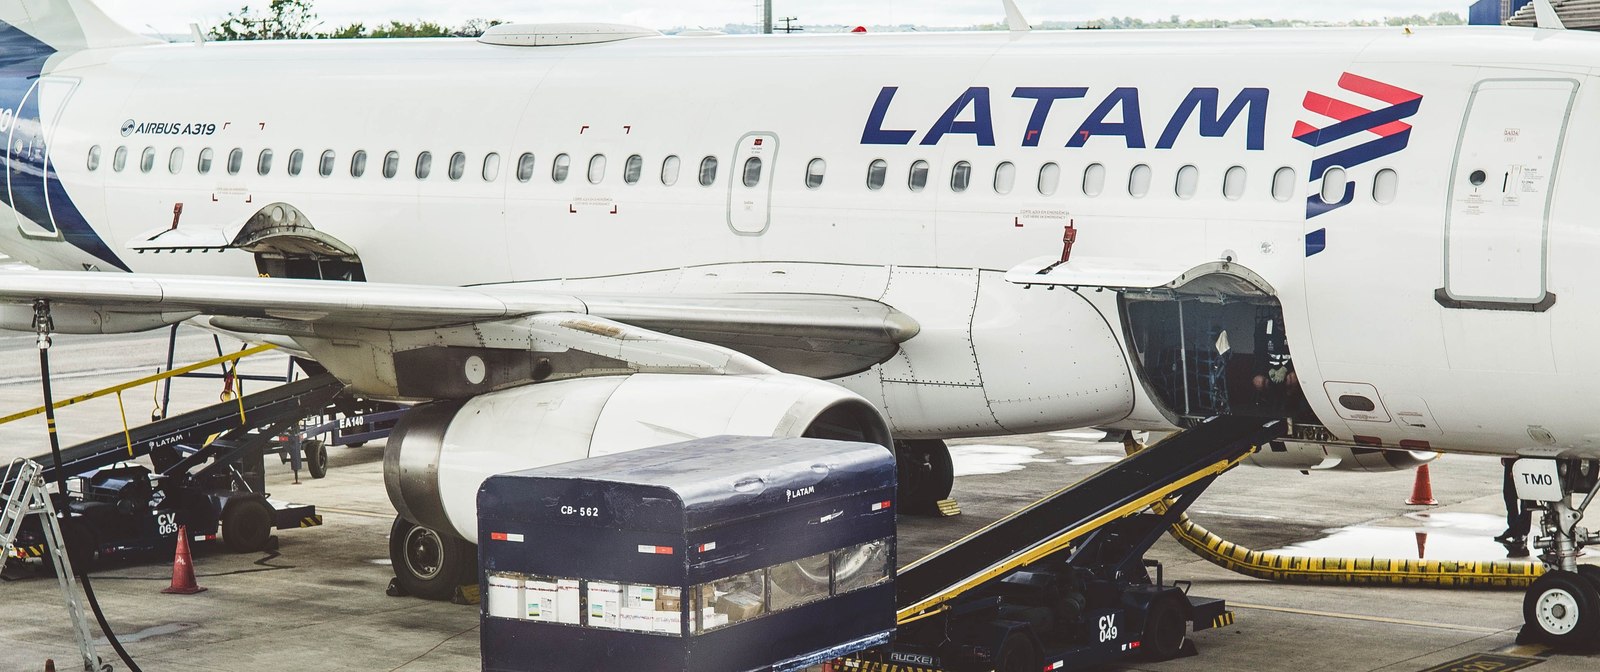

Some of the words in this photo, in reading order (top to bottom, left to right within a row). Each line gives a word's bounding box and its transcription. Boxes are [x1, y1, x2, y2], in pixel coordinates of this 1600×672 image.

[860, 86, 1269, 150] LATAM
[135, 122, 181, 135] AIRBUS
[181, 123, 216, 136] A319
[339, 416, 364, 429] EA140
[155, 434, 184, 448] LATAM
[792, 485, 815, 499] LATAM
[157, 512, 176, 526] CV
[159, 522, 178, 535] 063
[1098, 613, 1115, 630] CV
[1099, 626, 1118, 643] 049
